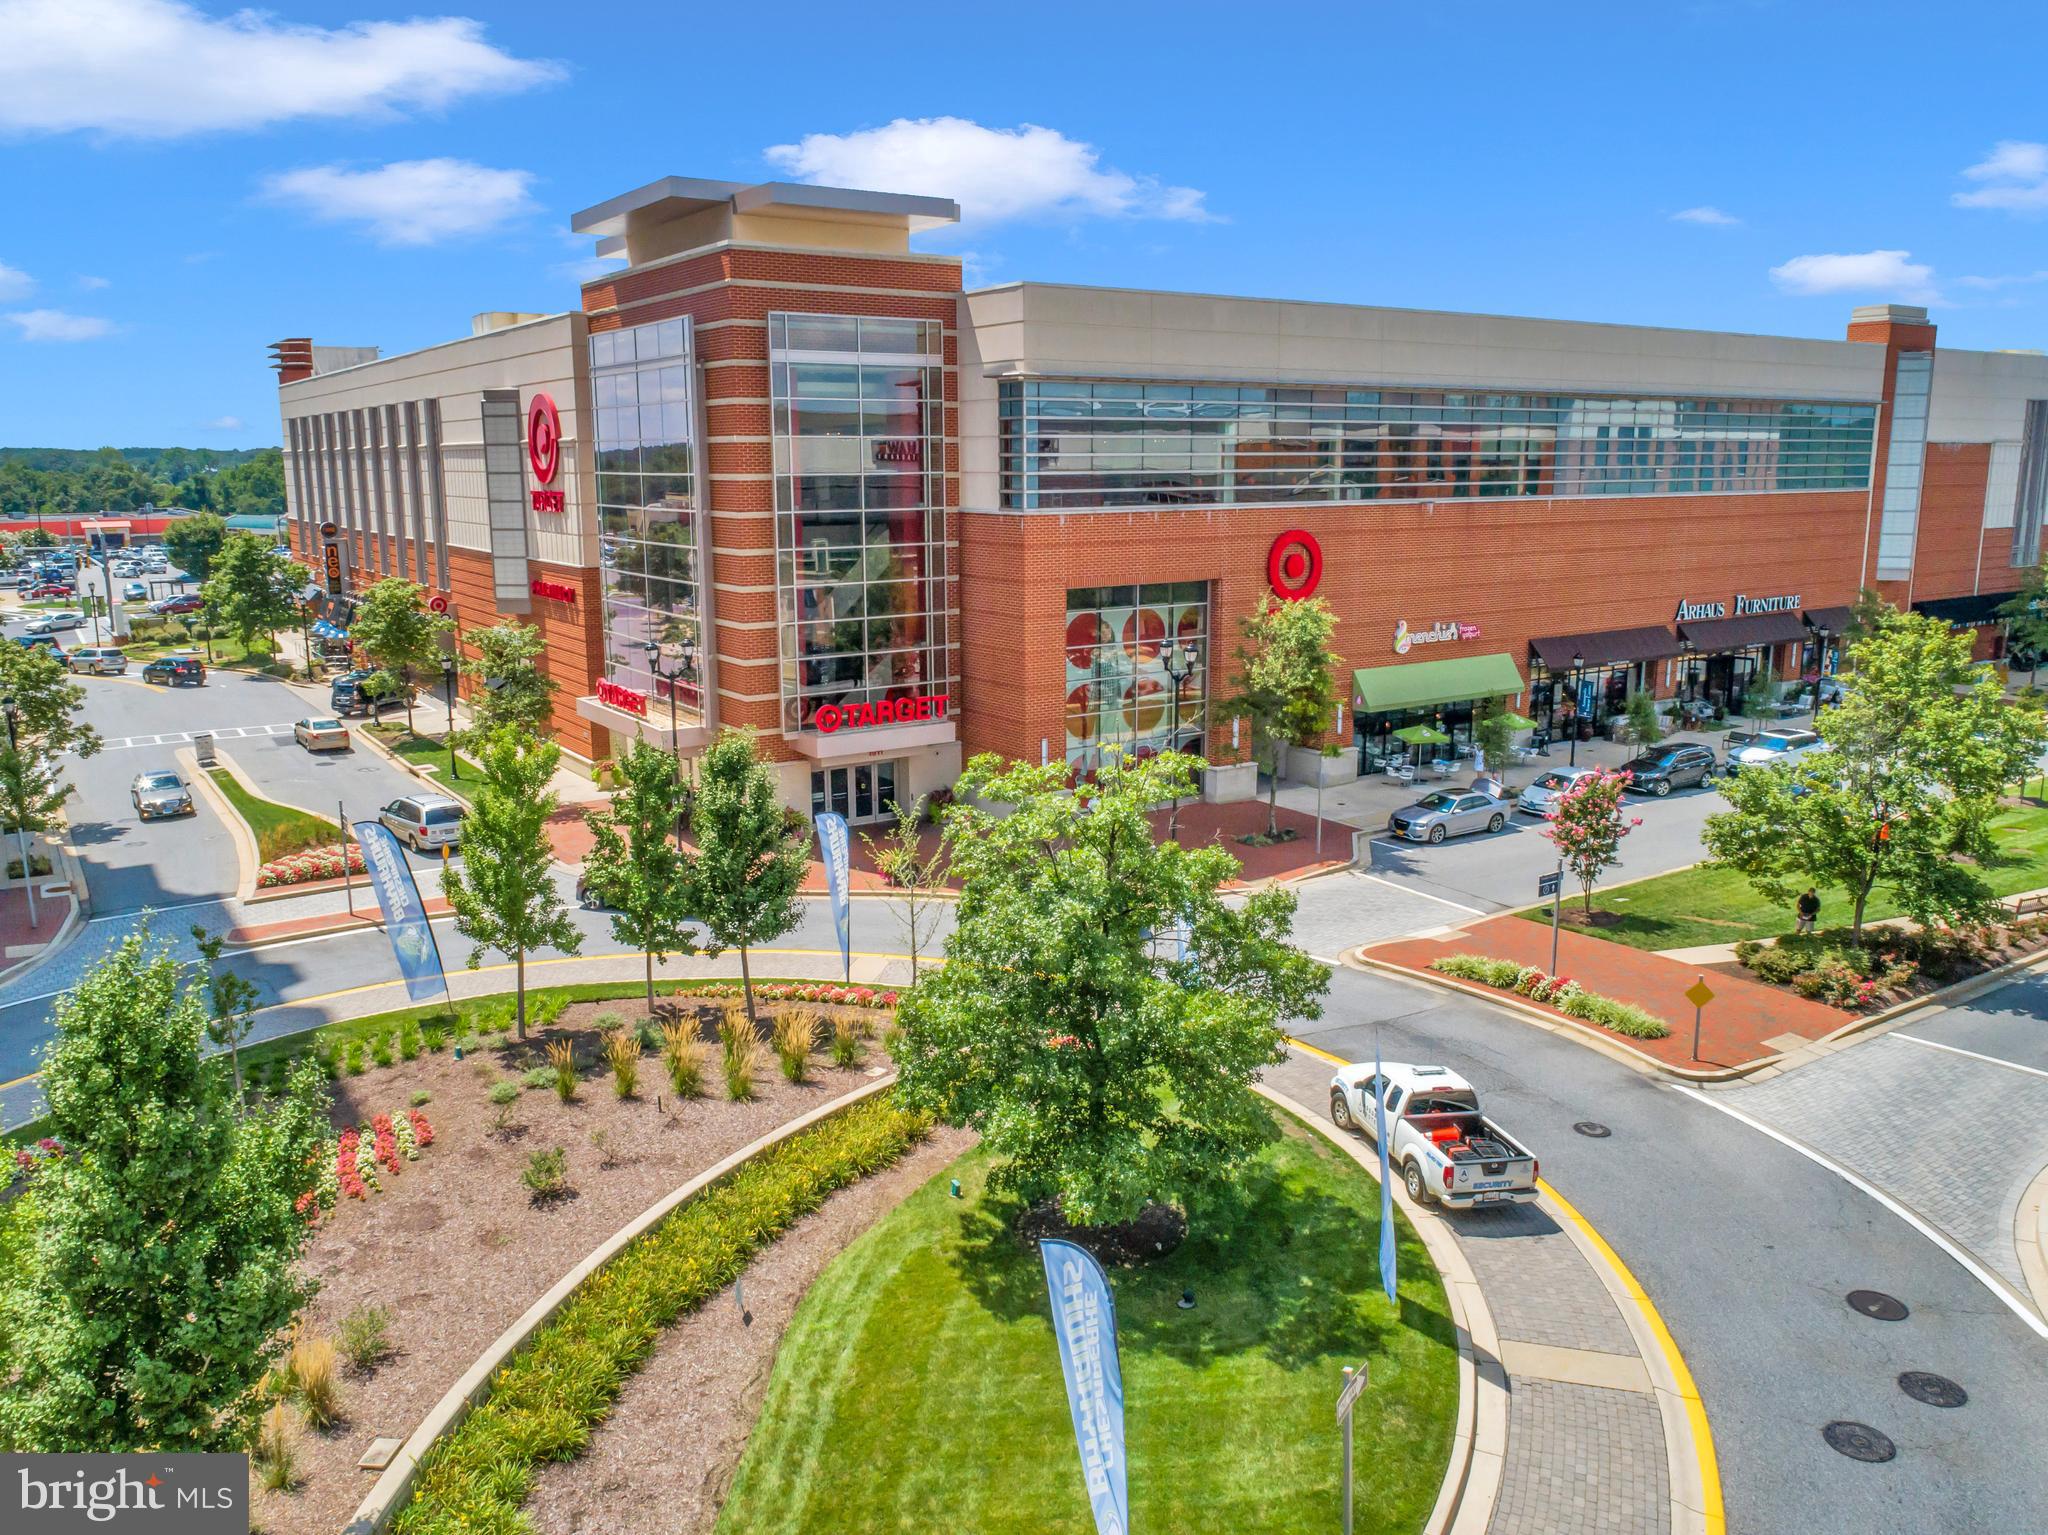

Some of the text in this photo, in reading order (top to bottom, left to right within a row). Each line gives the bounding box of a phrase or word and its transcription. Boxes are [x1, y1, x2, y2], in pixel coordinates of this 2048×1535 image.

[326, 546, 340, 578] neo
[1675, 595, 1800, 620] ARHAUS FURNITURE
[843, 695, 949, 729] TARGET
[1472, 1180, 1514, 1190] SECURITY
